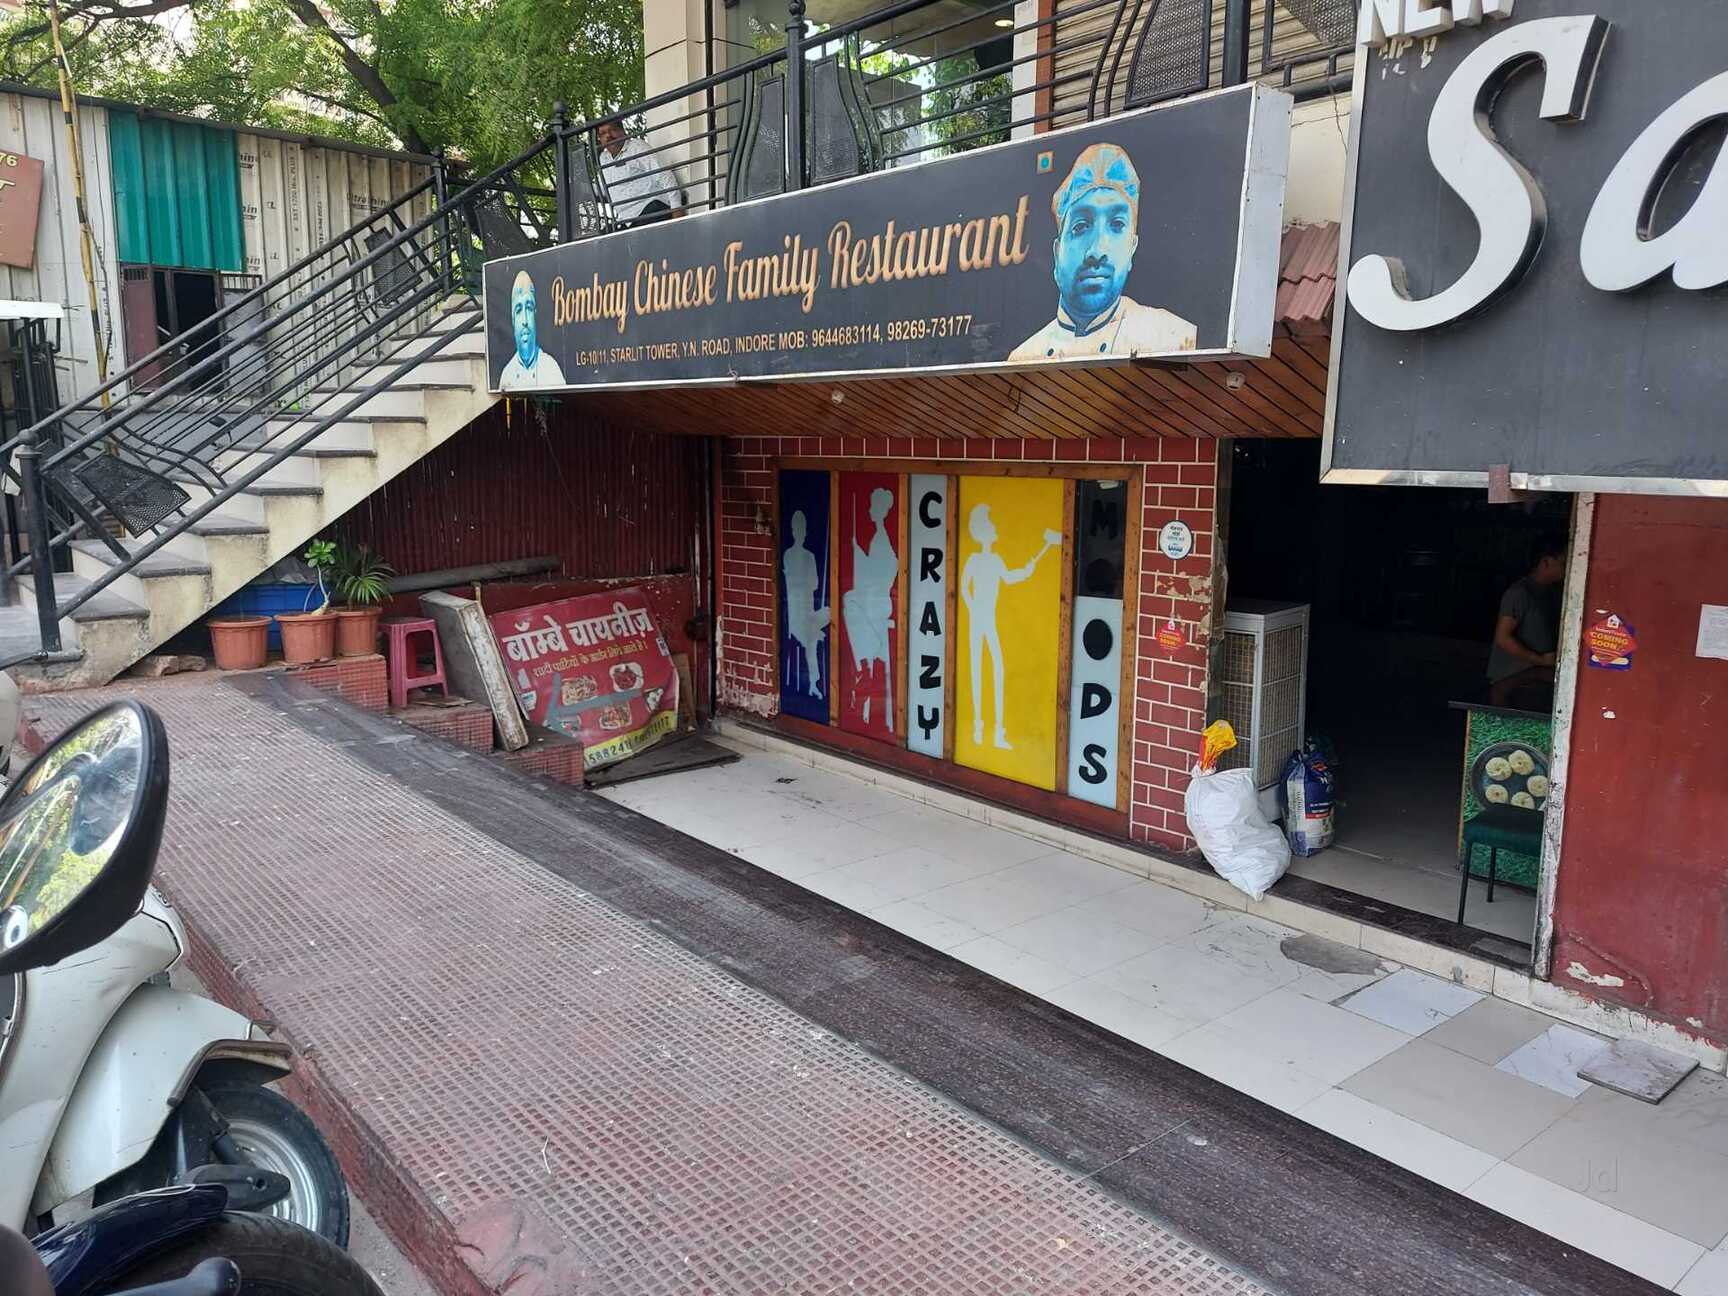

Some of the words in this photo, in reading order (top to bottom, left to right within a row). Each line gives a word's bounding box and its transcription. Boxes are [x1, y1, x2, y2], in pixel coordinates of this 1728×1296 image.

[551, 272, 630, 334] Bombay
[633, 258, 718, 317] Chinese
[723, 234, 821, 314] Family
[827, 194, 1030, 289] Restaurant
[610, 345, 644, 364] STARLIT
[701, 337, 733, 357] ROAD,
[735, 333, 776, 353] INDORE
[778, 330, 809, 350] MOB:
[811, 322, 884, 346] 9644683114,
[887, 314, 973, 341] 98269-73177
[501, 614, 569, 662] बॉम्बे
[918, 490, 944, 741] CRAZY
[1590, 630, 1629, 646] COMING
